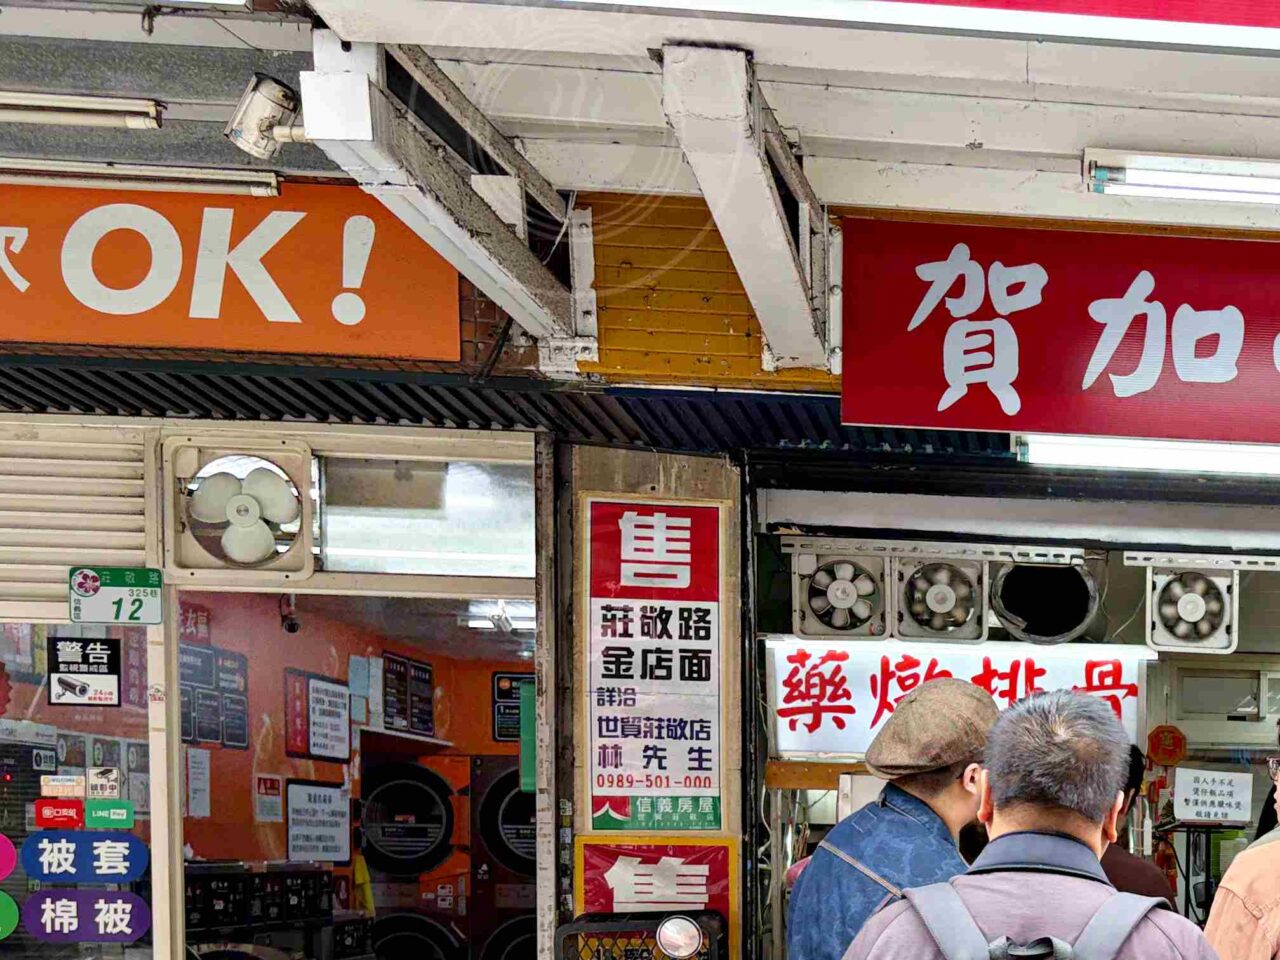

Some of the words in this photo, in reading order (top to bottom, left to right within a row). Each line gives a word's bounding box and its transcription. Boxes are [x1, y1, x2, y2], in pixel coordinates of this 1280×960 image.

[617, 511, 692, 590] 售
[112, 597, 144, 621] 12
[601, 604, 712, 642] 莊敬路
[56, 640, 112, 664] 警告
[601, 646, 712, 682] 金店面
[596, 687, 637, 707] 詳洽
[597, 715, 712, 741] 世貿莊敬店
[597, 743, 713, 772] 林先生
[596, 774, 713, 788] 0989-501-000
[92, 810, 110, 818] LINE
[636, 797, 715, 813] 信義房屋
[38, 838, 130, 876] 被套
[41, 897, 133, 935] 棉被
